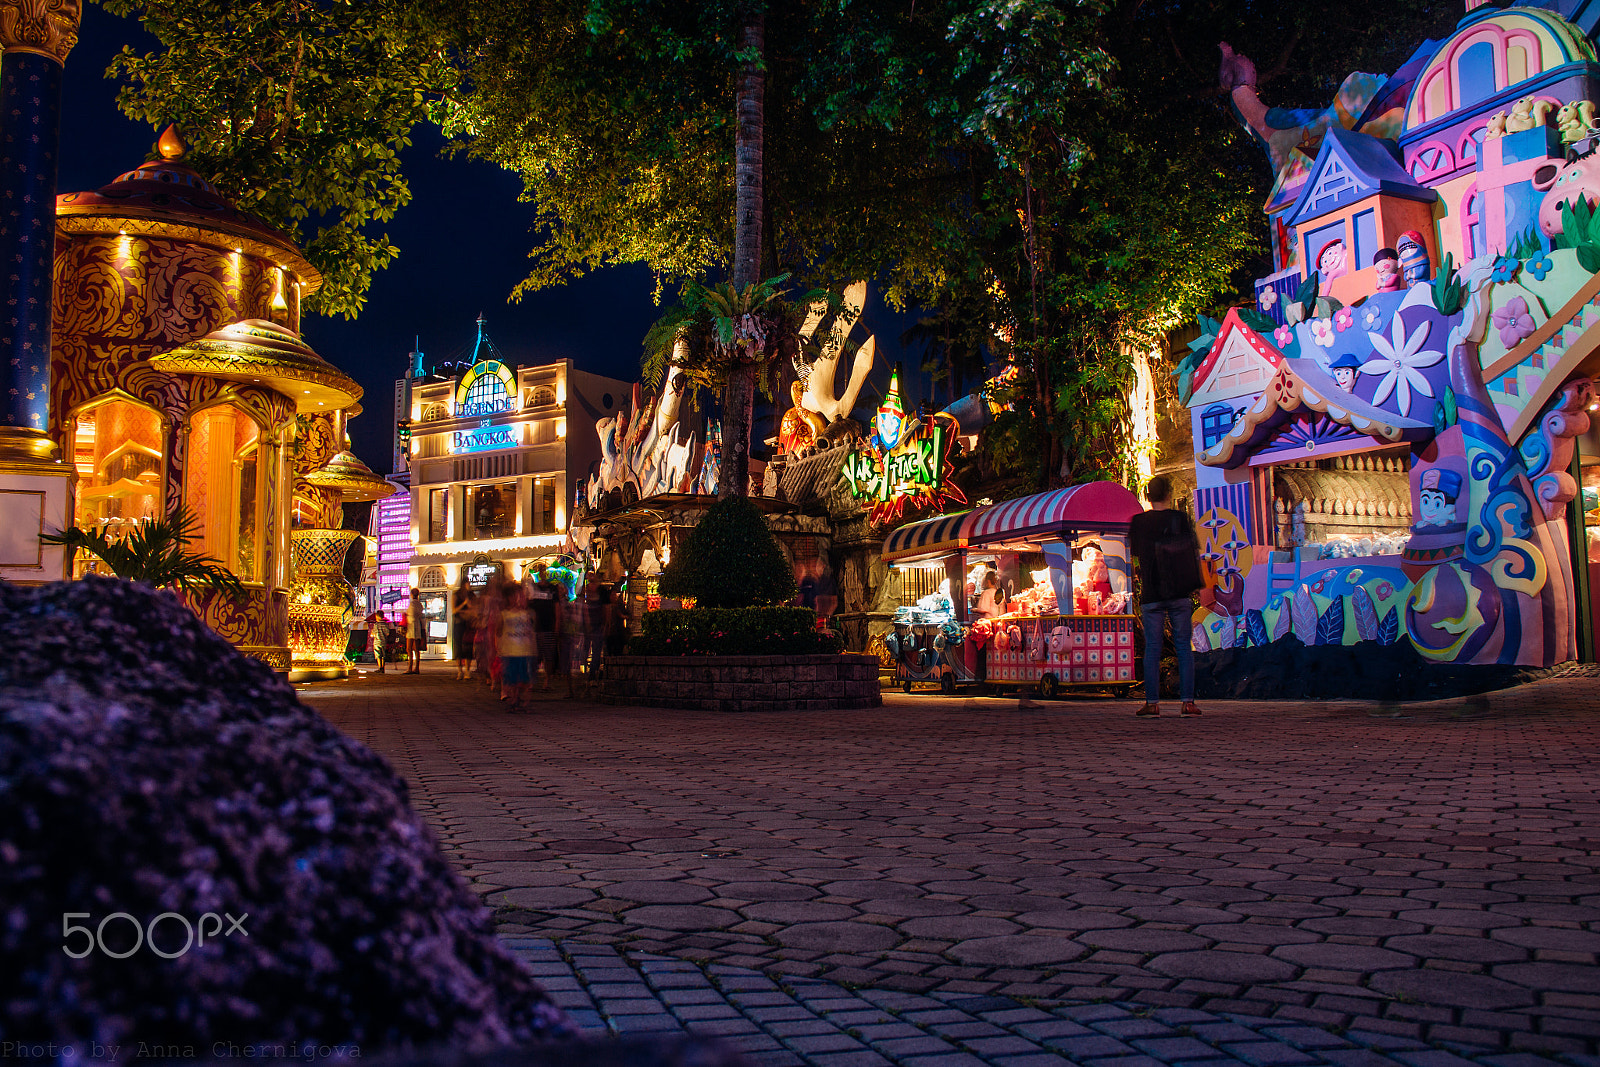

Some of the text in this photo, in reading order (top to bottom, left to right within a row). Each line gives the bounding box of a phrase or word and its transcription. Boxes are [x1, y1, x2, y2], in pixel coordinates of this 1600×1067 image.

[453, 397, 515, 417] LEGENDE
[453, 430, 514, 448] BANGKOK
[841, 452, 873, 498] YAK
